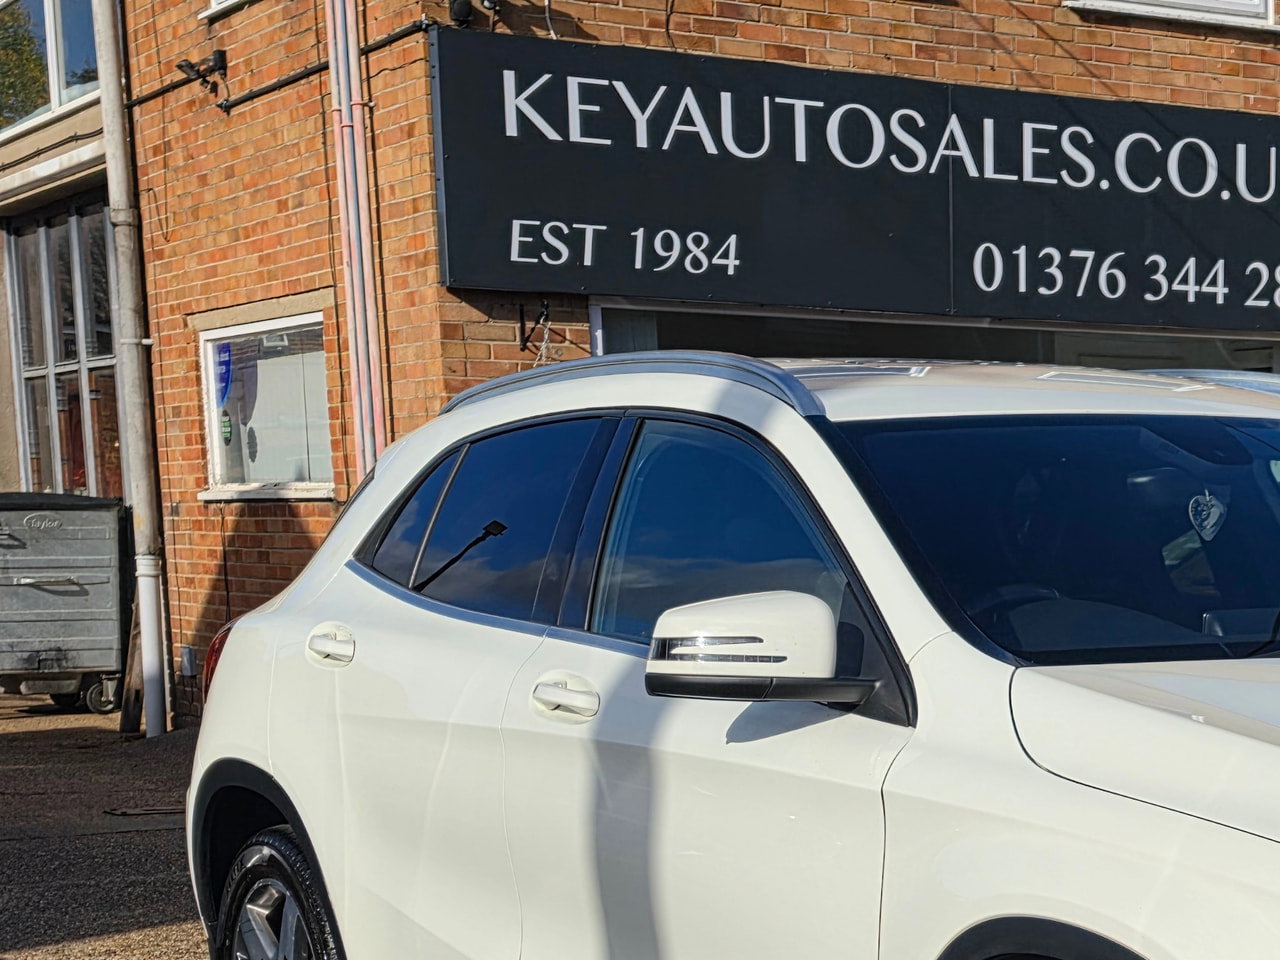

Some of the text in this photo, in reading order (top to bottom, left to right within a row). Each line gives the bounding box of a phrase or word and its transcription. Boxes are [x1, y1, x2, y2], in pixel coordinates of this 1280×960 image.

[510, 219, 741, 275] EST 1984
[972, 242, 1127, 299] 01376
[1143, 254, 1229, 304] 344
